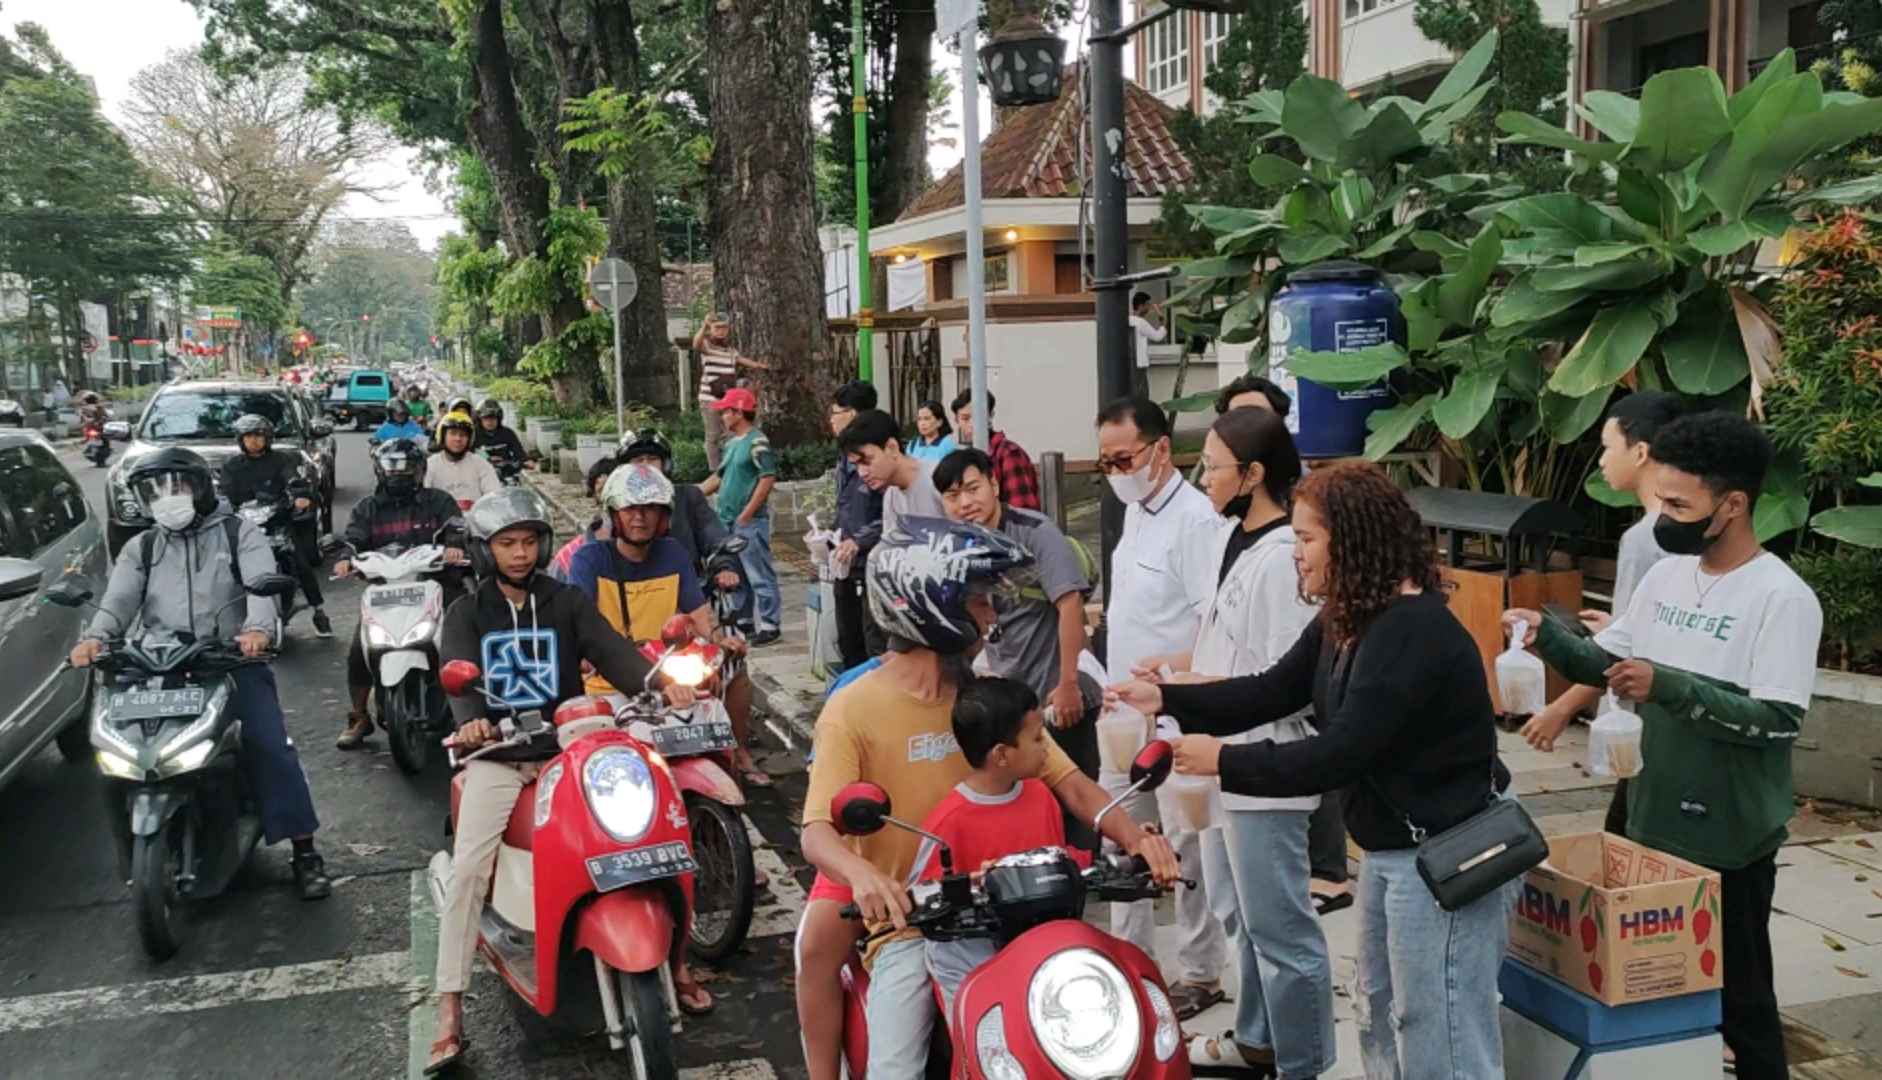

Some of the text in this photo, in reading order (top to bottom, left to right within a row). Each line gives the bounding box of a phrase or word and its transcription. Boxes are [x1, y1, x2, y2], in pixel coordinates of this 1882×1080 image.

[590, 844, 688, 876] B 3539 BVC
[1619, 904, 1685, 940] HBM
